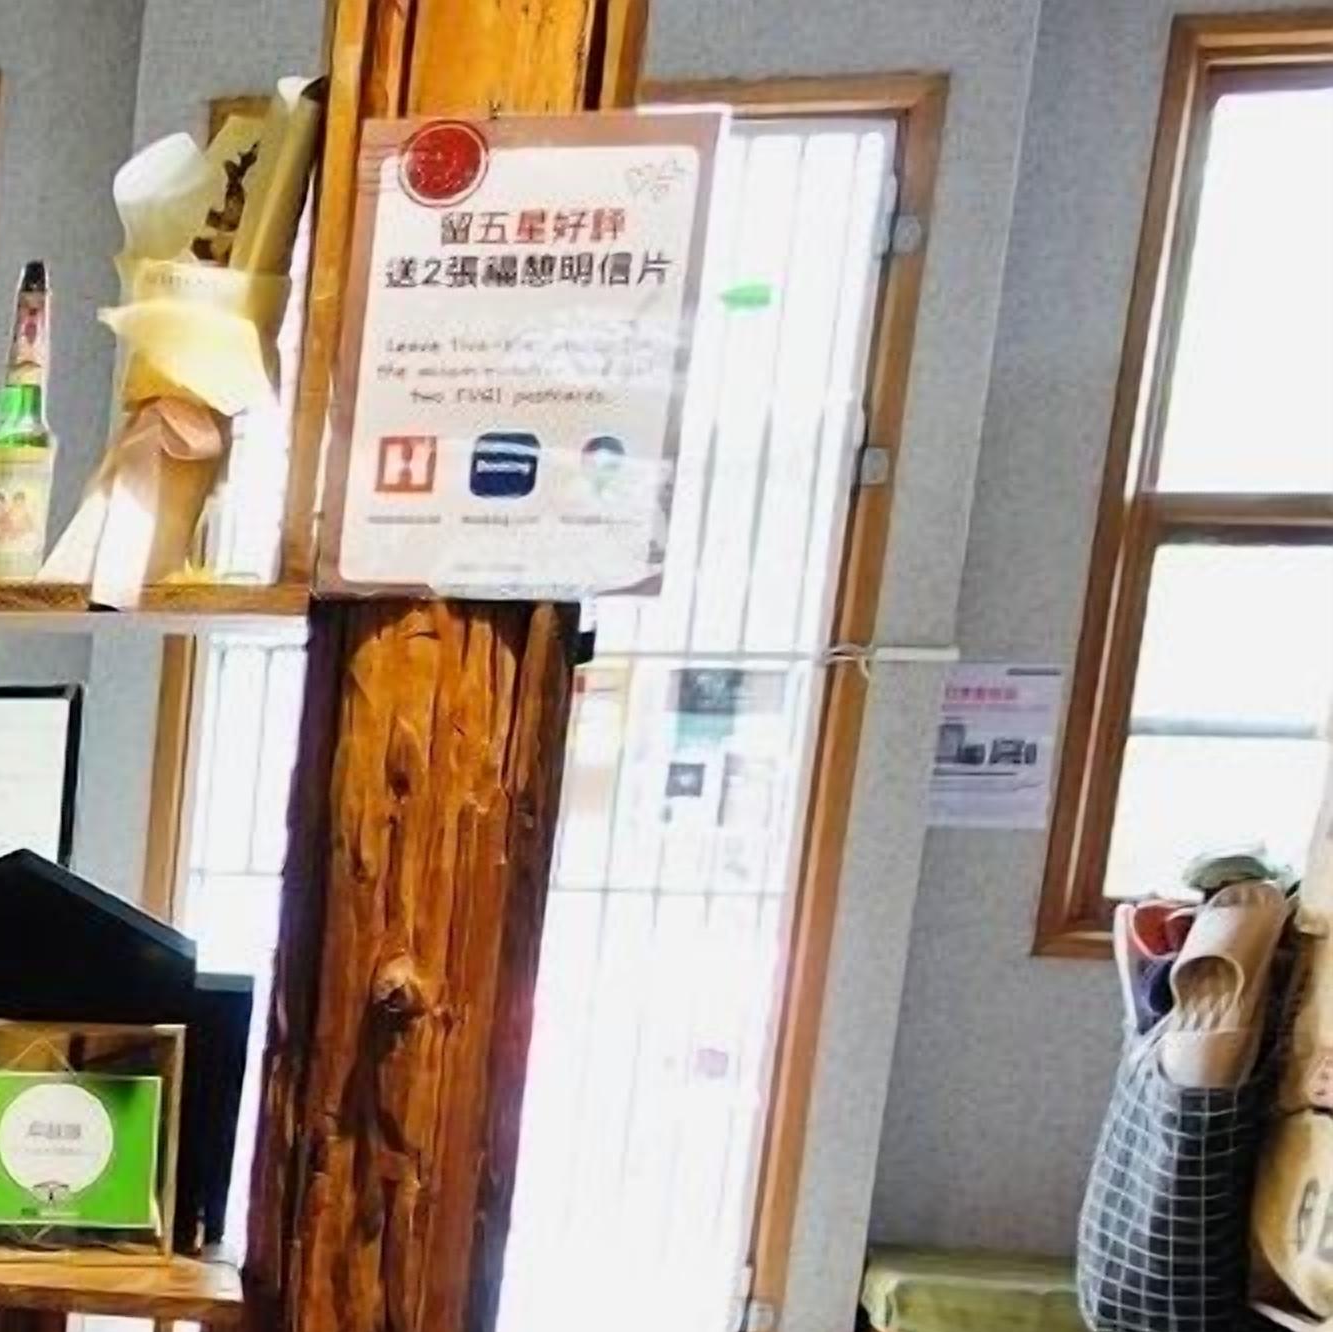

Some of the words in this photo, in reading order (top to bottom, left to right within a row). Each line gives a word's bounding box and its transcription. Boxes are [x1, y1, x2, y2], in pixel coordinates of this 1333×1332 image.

[440, 208, 626, 246] 留五星好評
